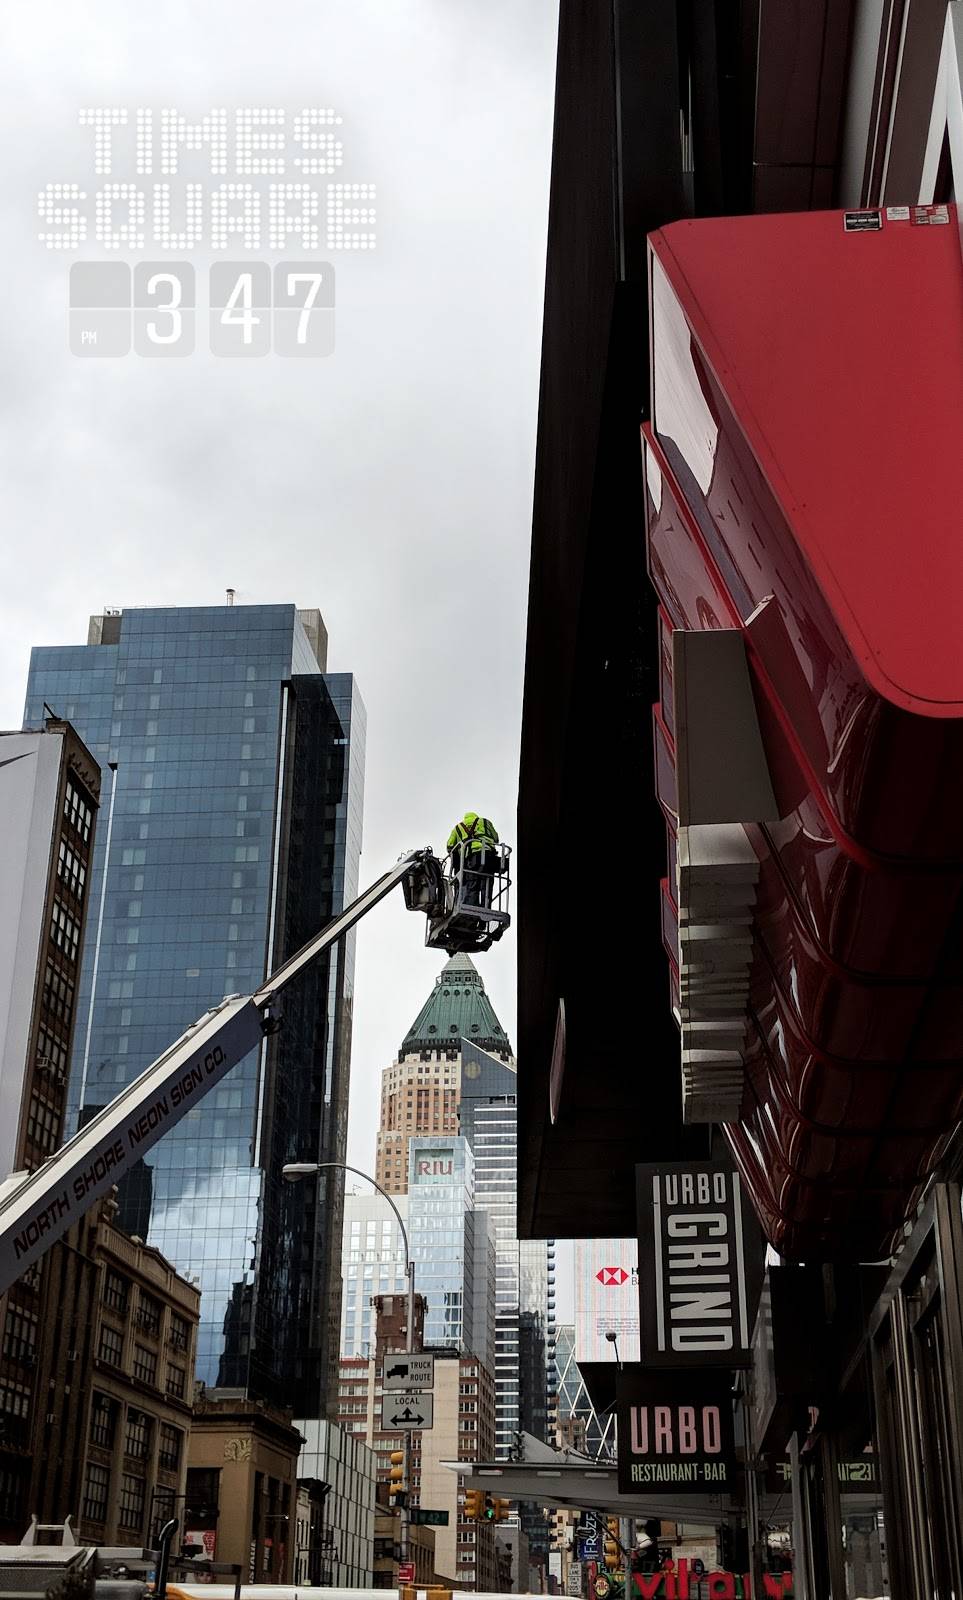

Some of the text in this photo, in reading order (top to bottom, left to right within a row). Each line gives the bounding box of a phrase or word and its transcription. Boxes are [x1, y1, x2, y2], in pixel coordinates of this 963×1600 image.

[12, 1191, 71, 1260] NORTH
[73, 1139, 126, 1201] SHORE
[127, 1096, 170, 1149] NEON
[170, 1067, 204, 1107] SIGN
[418, 1160, 453, 1176] RIU
[665, 1172, 727, 1205] URBO
[667, 1212, 734, 1352] GRIND
[410, 1361, 432, 1369] TRUCK
[410, 1373, 431, 1382] ROUTE
[395, 1397, 420, 1405] LOCAL
[630, 1406, 722, 1454] URBO
[631, 1462, 727, 1482] RESTAURANT-BAR
